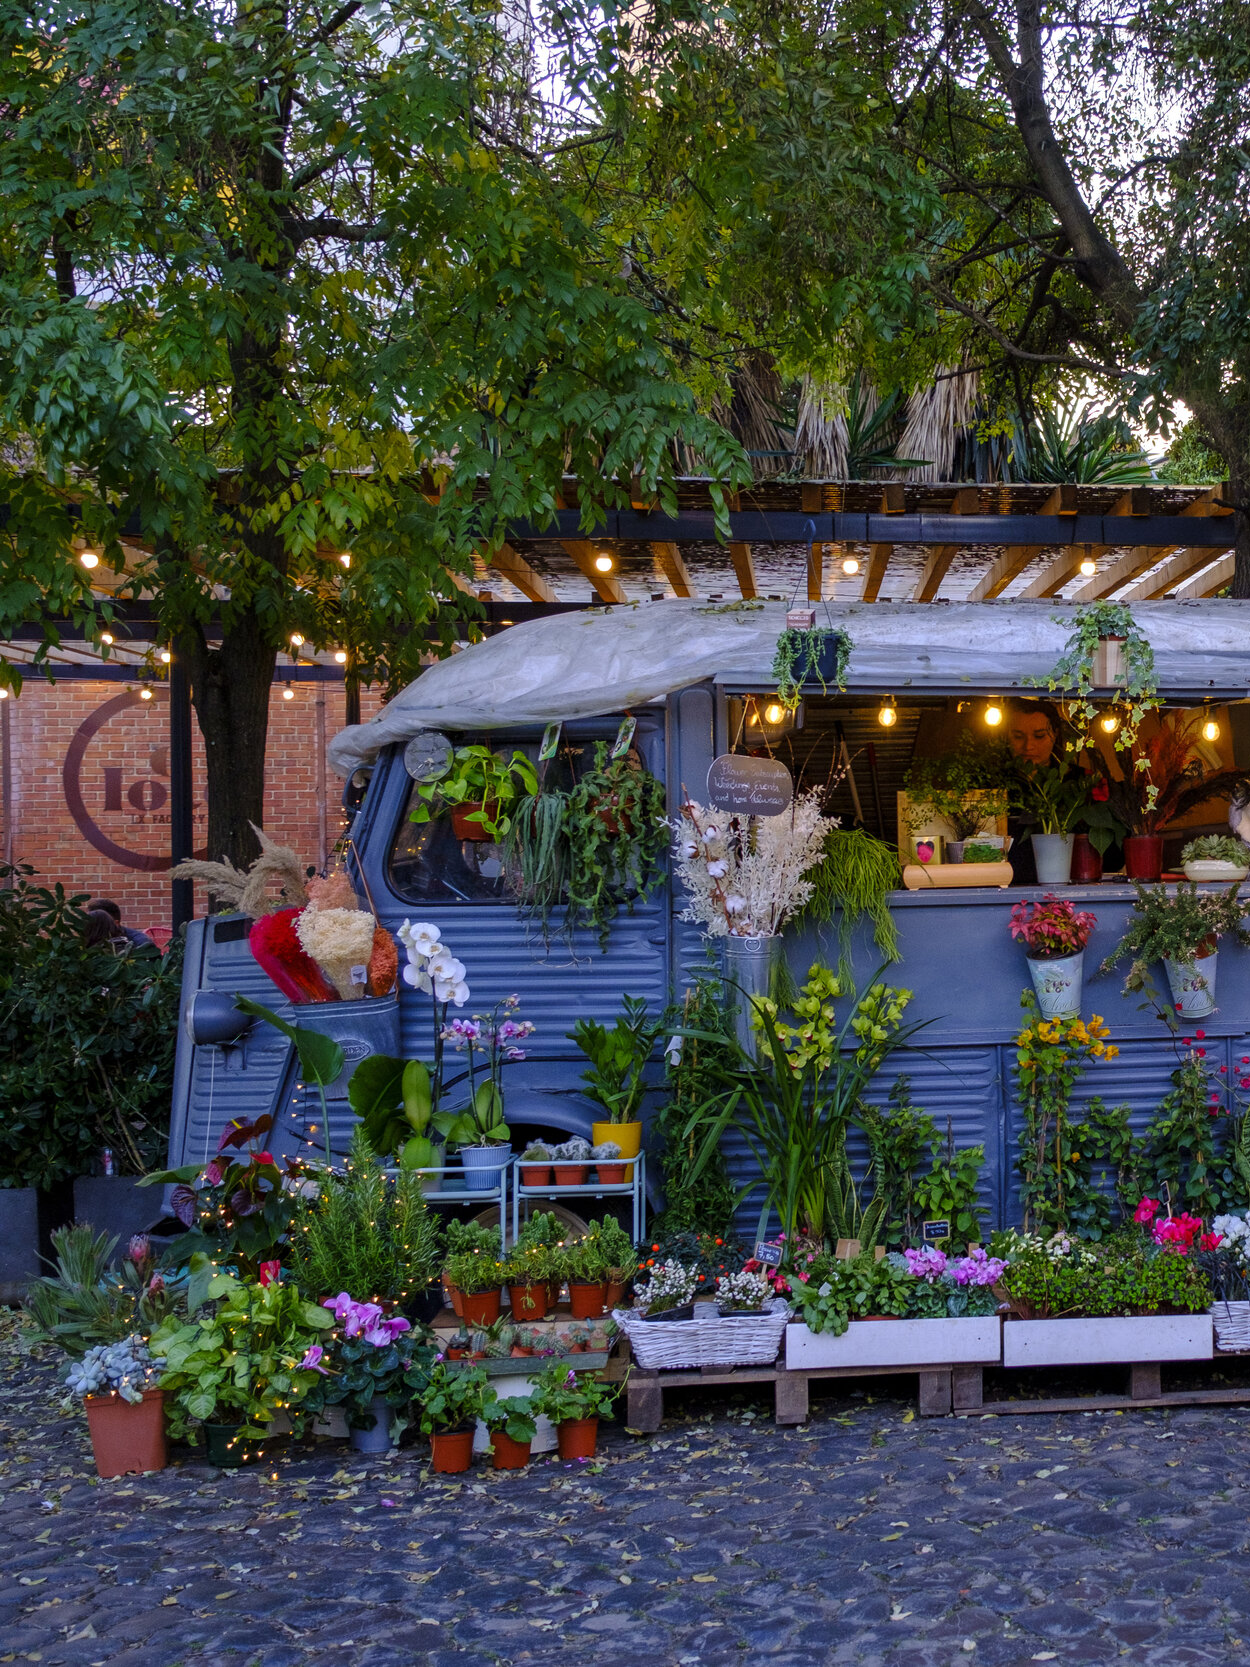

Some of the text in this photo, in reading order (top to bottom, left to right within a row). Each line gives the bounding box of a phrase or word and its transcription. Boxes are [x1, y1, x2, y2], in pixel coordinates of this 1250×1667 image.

[715, 793, 729, 802] and
[131, 815, 206, 824] LX FACRY
